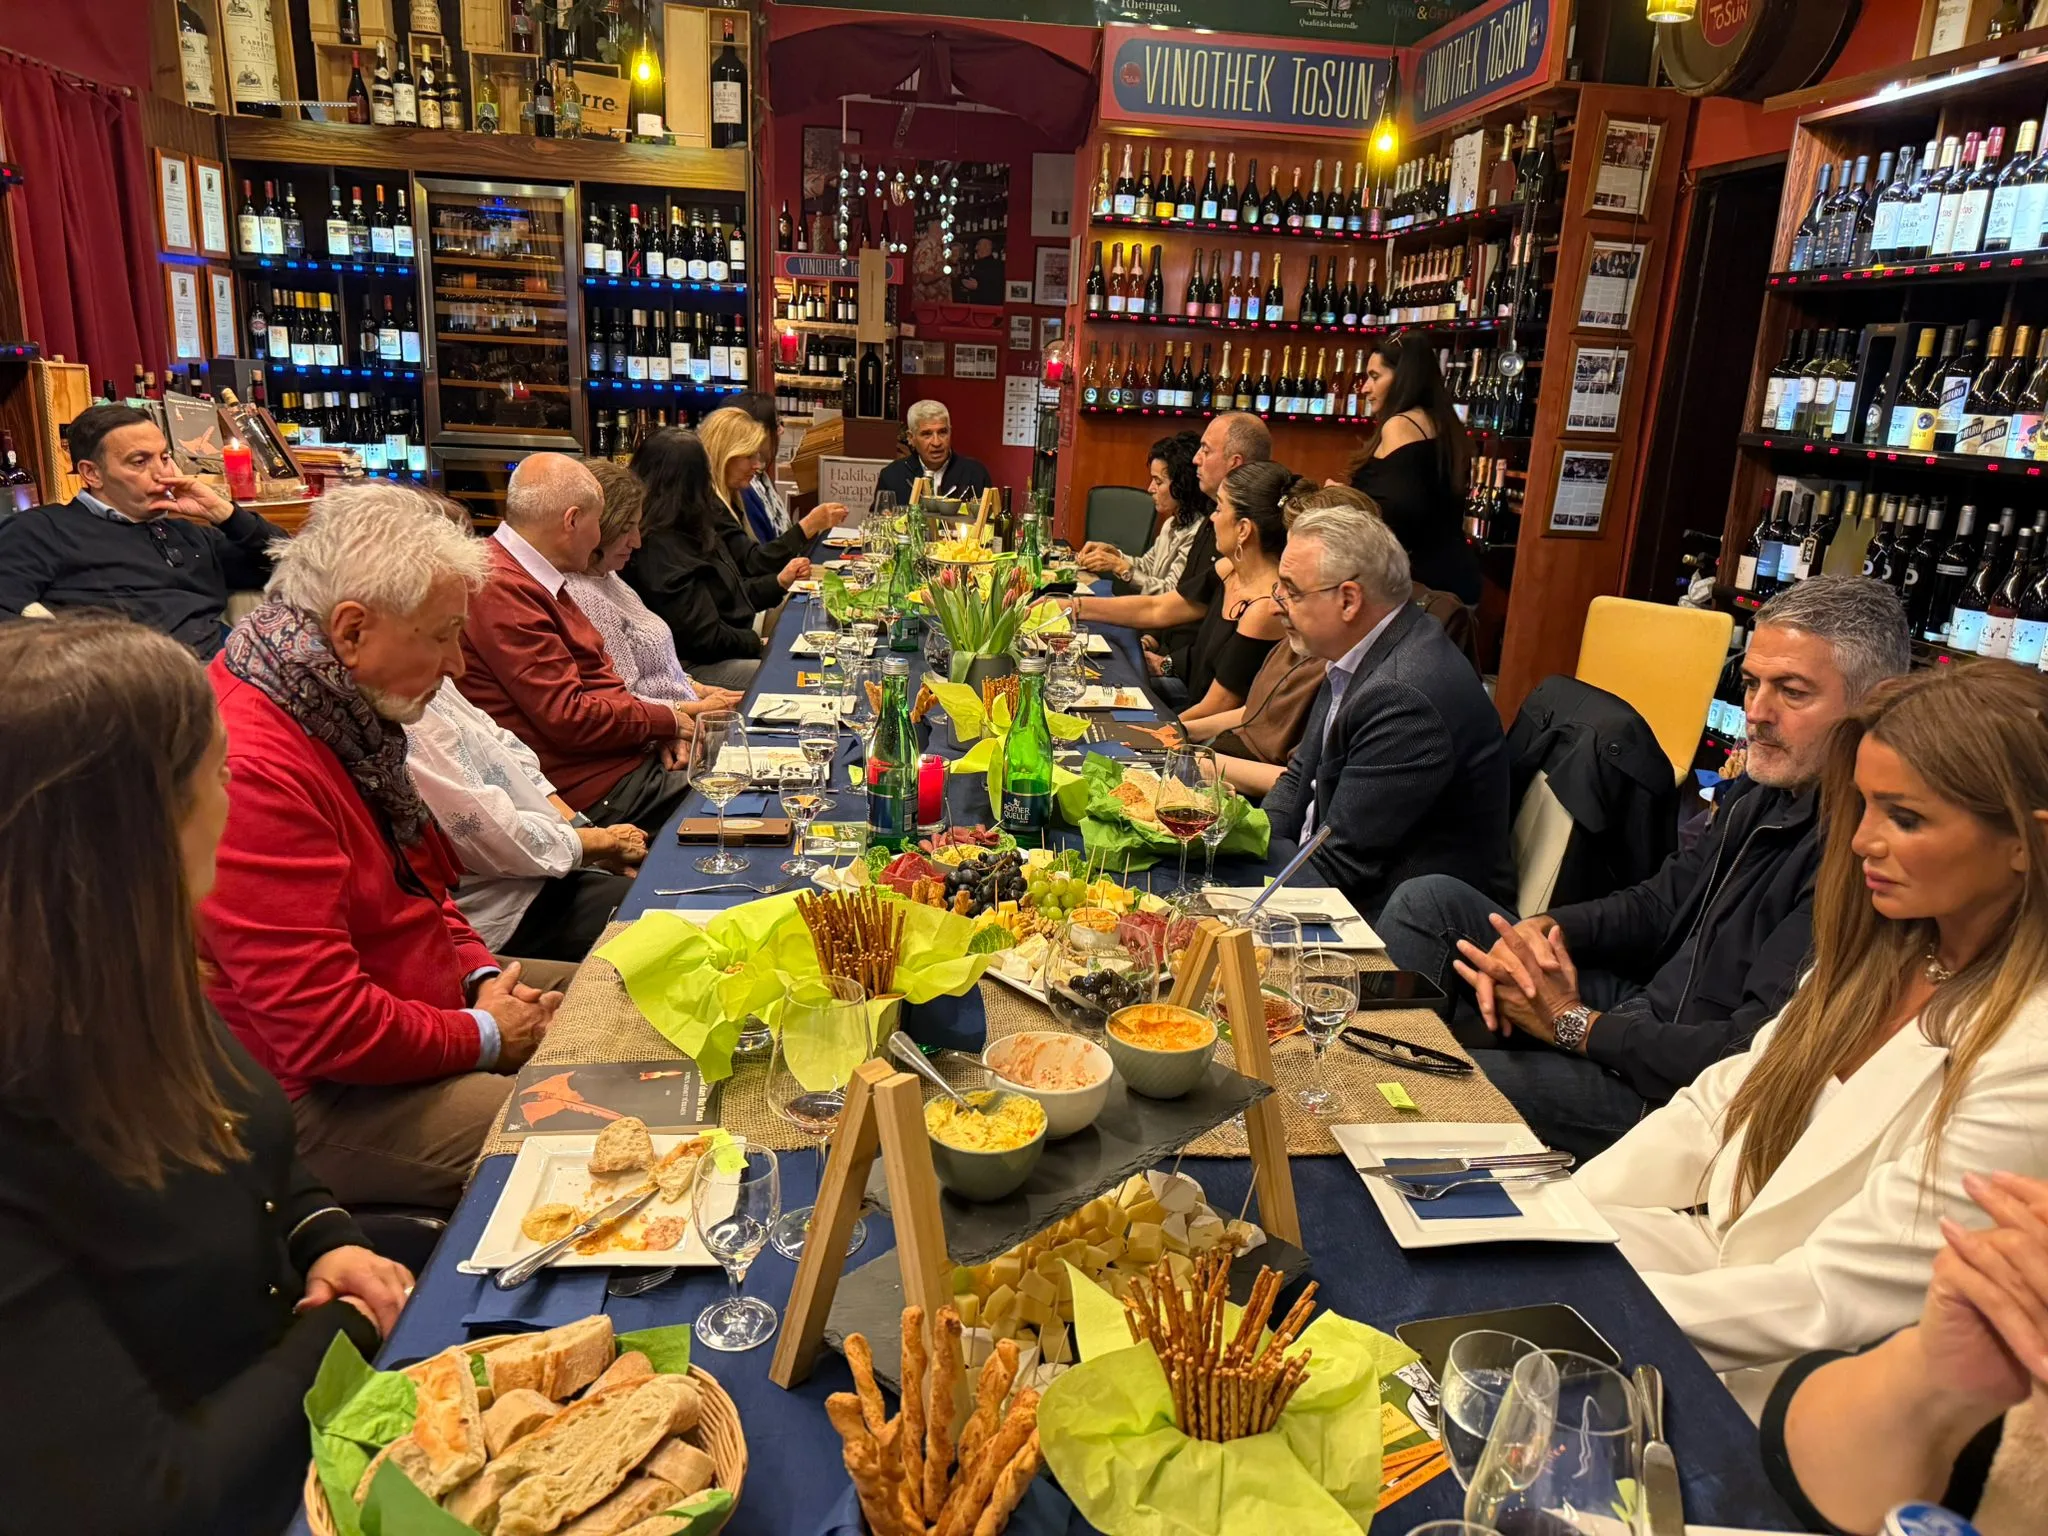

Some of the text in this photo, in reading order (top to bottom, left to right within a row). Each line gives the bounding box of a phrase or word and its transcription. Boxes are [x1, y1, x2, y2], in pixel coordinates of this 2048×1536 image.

[1120, 0, 1181, 14] Rheingau.
[1308, 8, 1353, 19] Ahmet bei der
[1416, 5, 1428, 20] &
[1299, 18, 1359, 29] Qualitätskontrolle
[1424, 25, 1483, 112] VINOTHEK
[1145, 45, 1276, 113] VINOTHEK
[581, 93, 616, 112] rre
[799, 257, 846, 276] VINOTHEK
[830, 482, 874, 502] Şarapt
